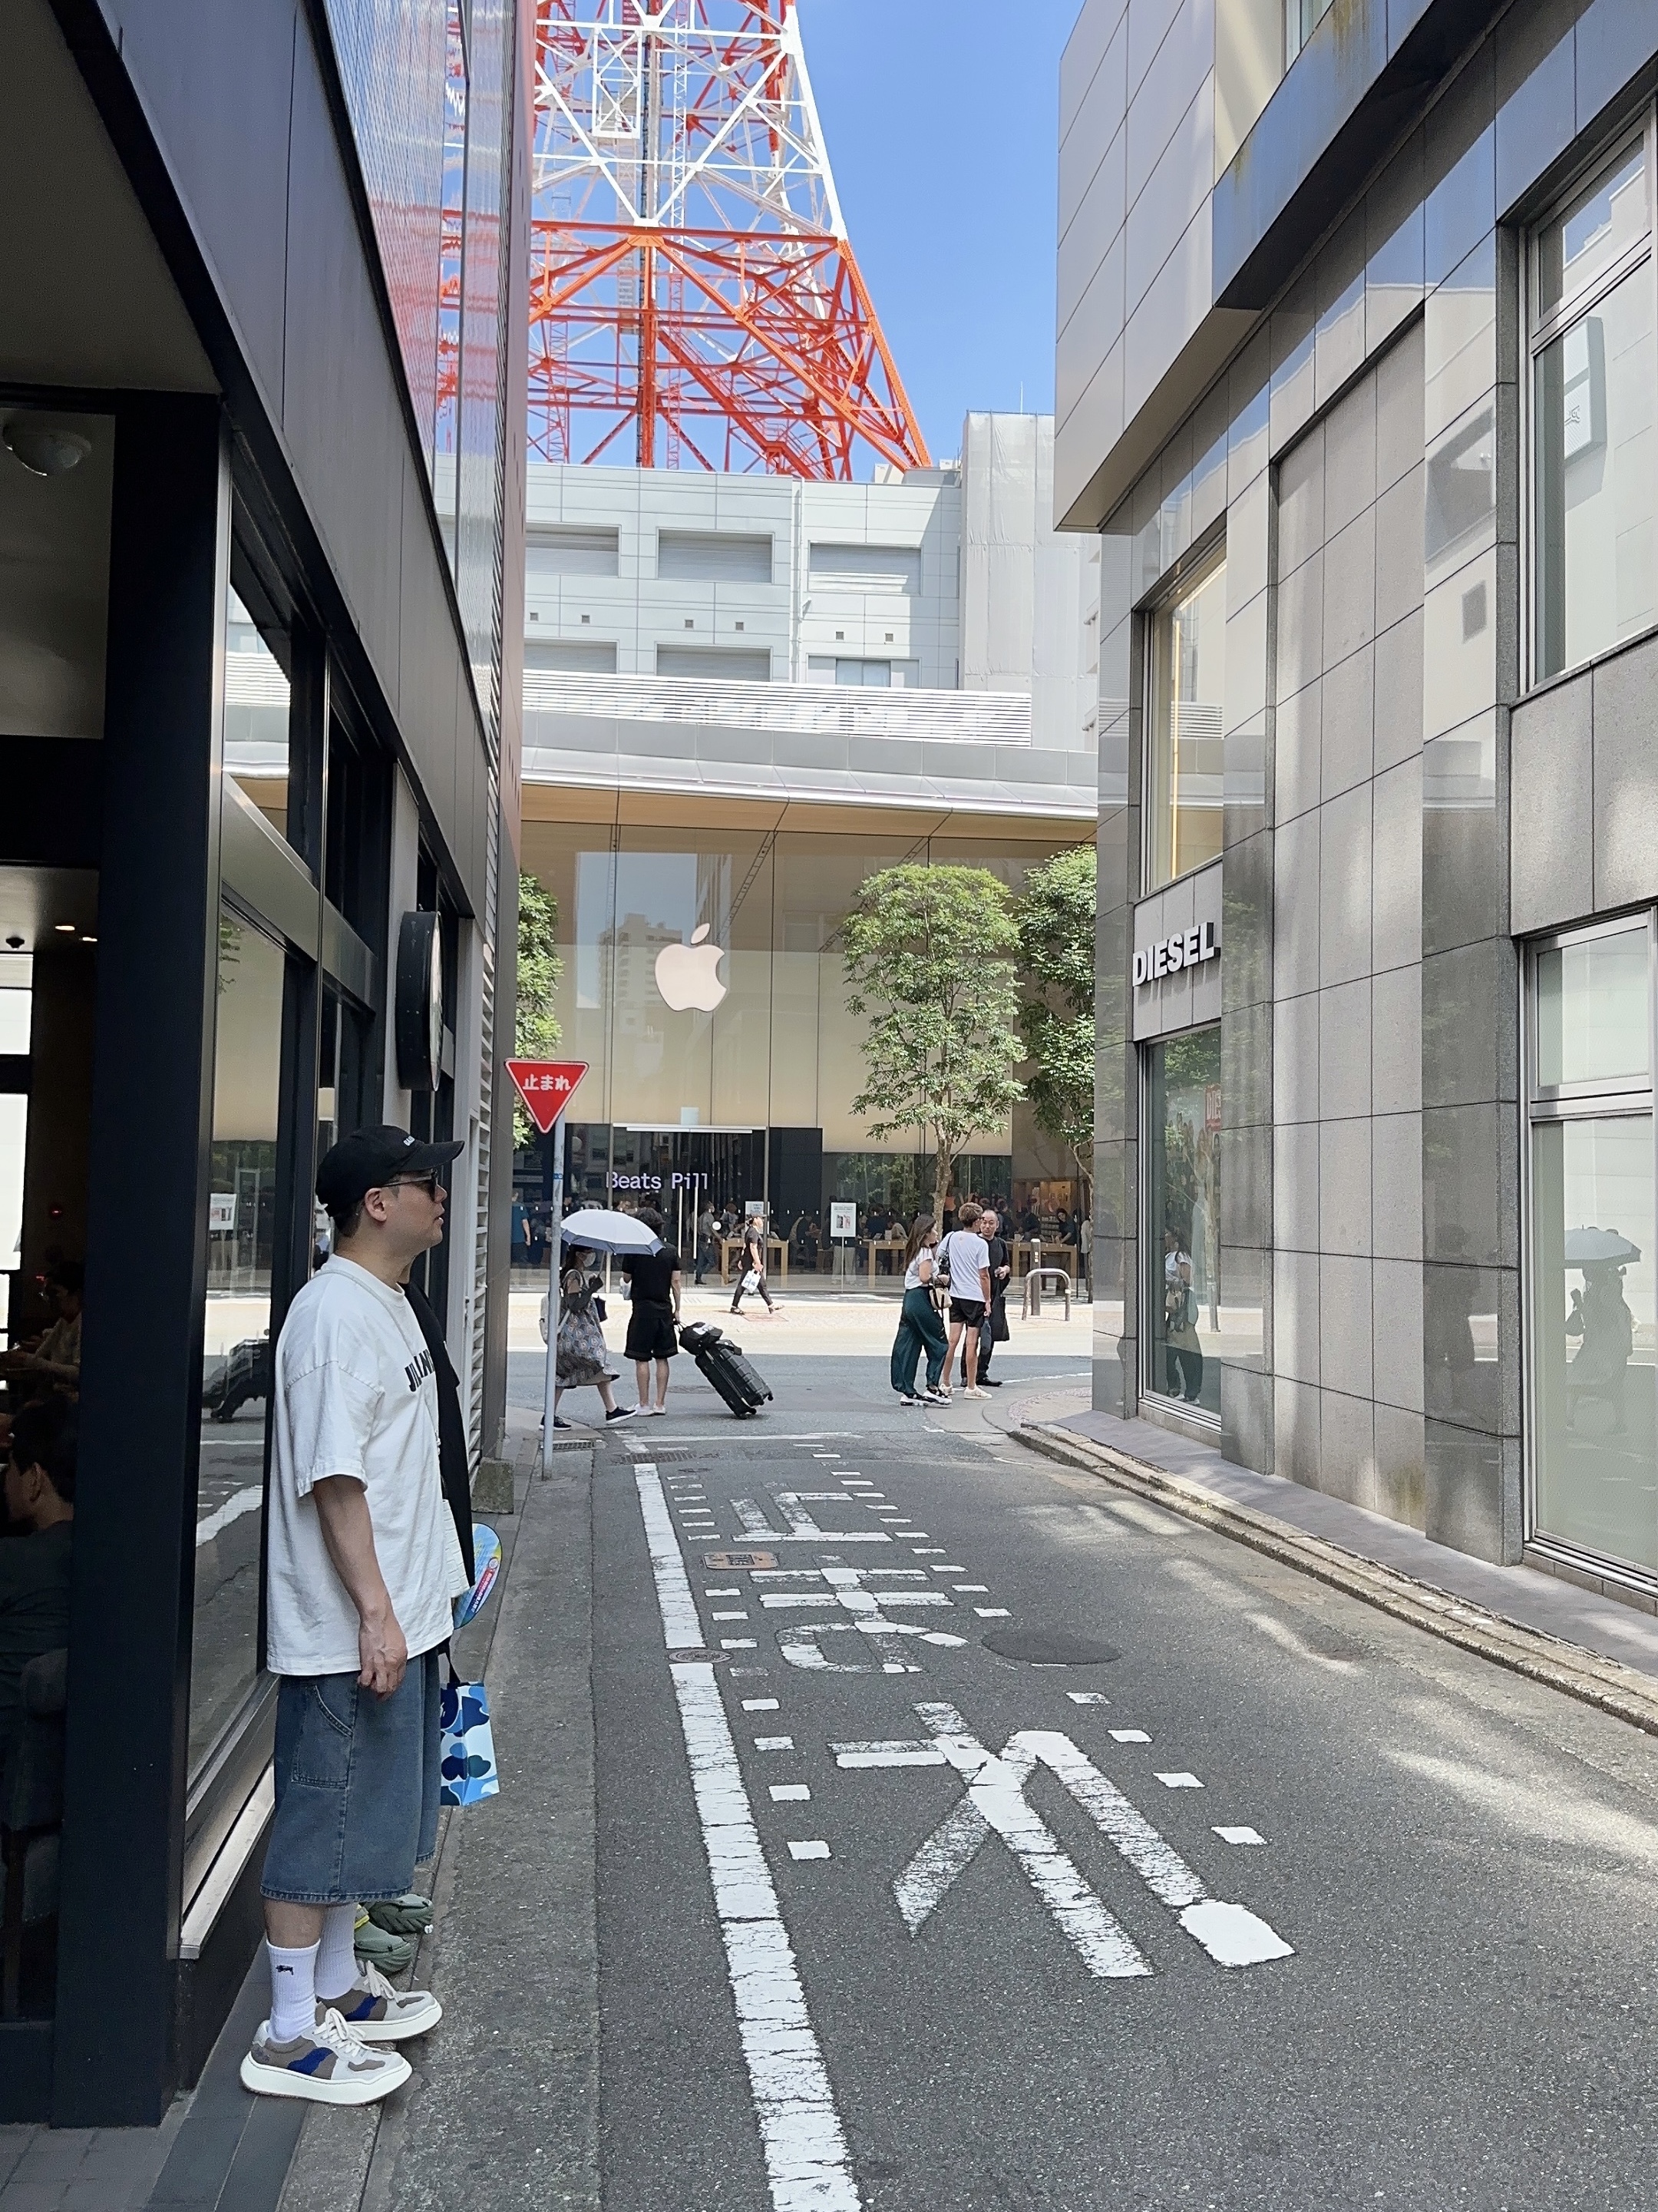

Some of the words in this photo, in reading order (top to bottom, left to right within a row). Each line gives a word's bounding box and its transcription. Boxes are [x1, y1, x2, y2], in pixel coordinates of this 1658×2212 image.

[1133, 922, 1216, 987] DIESEL
[522, 1073, 571, 1091] 止まれ
[606, 1172, 662, 1189] Beats
[672, 1172, 708, 1190] Pill
